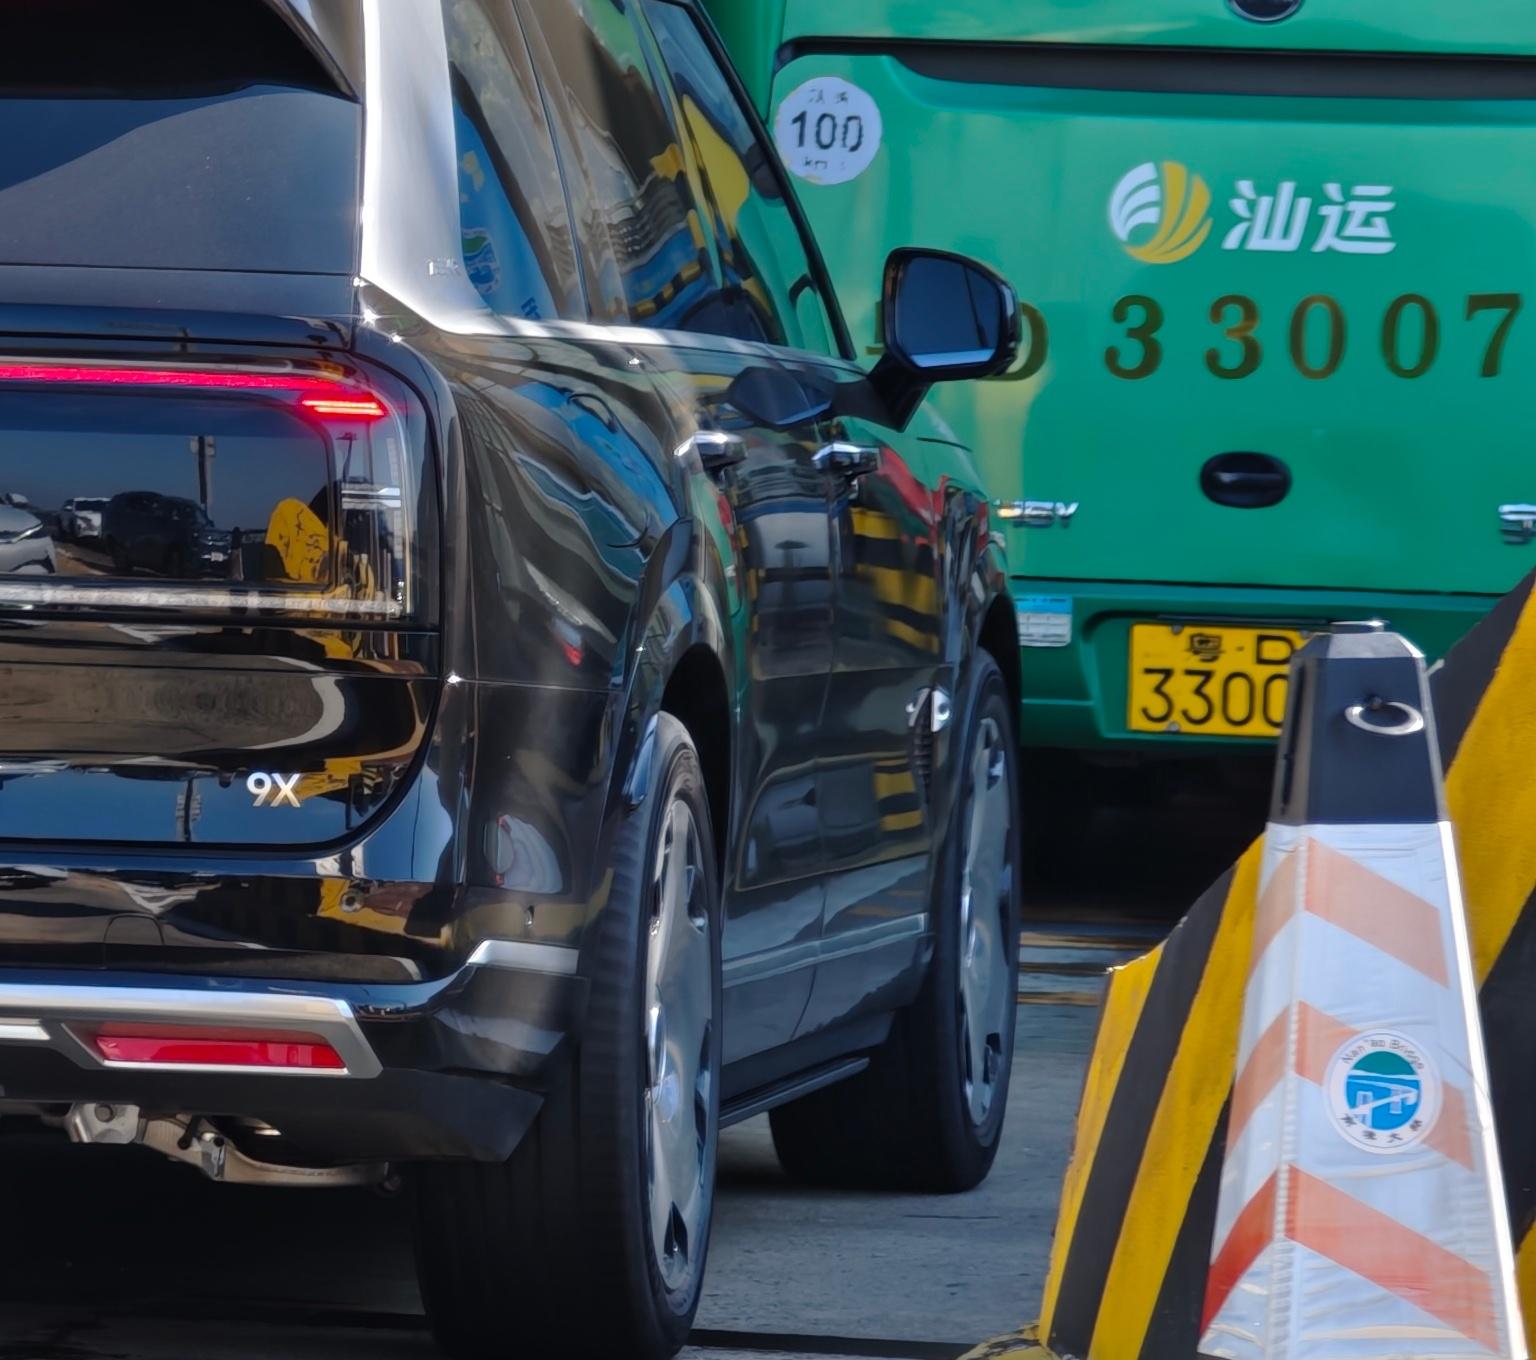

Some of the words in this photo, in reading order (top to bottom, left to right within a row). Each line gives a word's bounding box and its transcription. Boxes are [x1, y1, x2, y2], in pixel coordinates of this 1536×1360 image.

[791, 110, 864, 152] 100
[1220, 178, 1397, 255] 汕运
[1140, 668, 1290, 727] 3300
[246, 771, 301, 809] 9X
